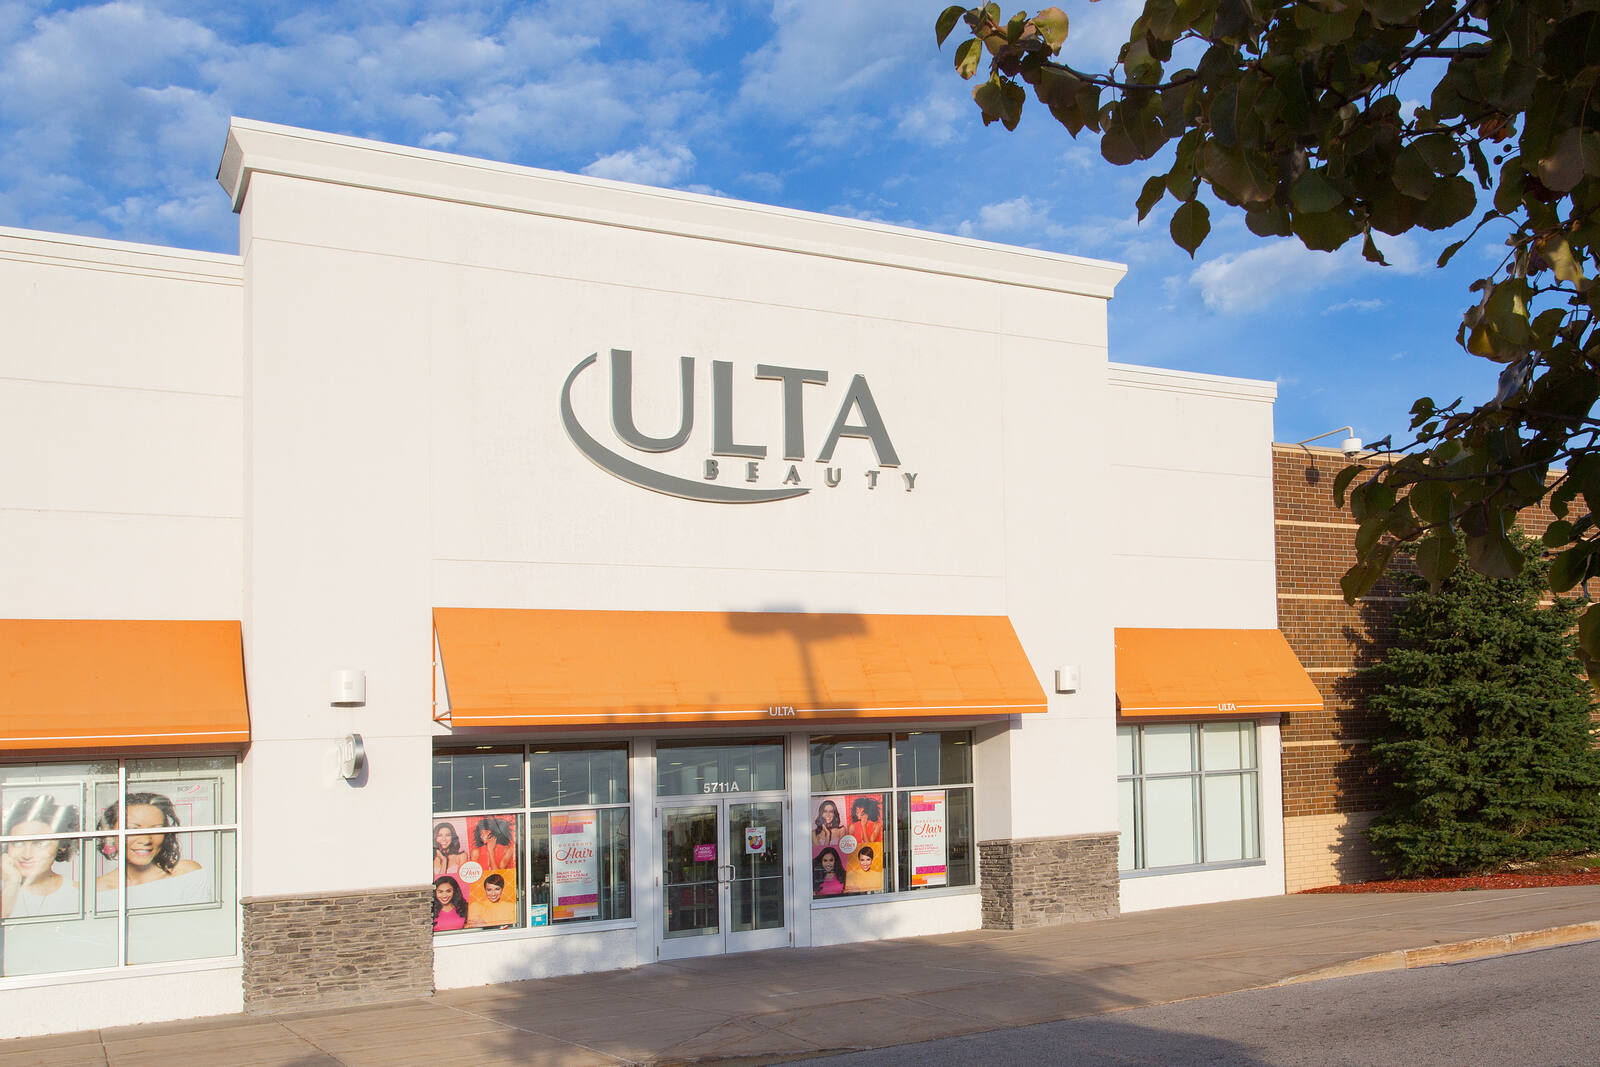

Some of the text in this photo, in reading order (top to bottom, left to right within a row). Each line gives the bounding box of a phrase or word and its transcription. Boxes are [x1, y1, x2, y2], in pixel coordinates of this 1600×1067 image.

[610, 348, 902, 468] ULTA
[703, 459, 918, 492] BEAUTY
[769, 706, 795, 716] ULTA
[1218, 703, 1236, 711] ULTA
[703, 781, 740, 793] 5711A
[914, 823, 942, 835] Hair
[555, 847, 593, 861] Hair
